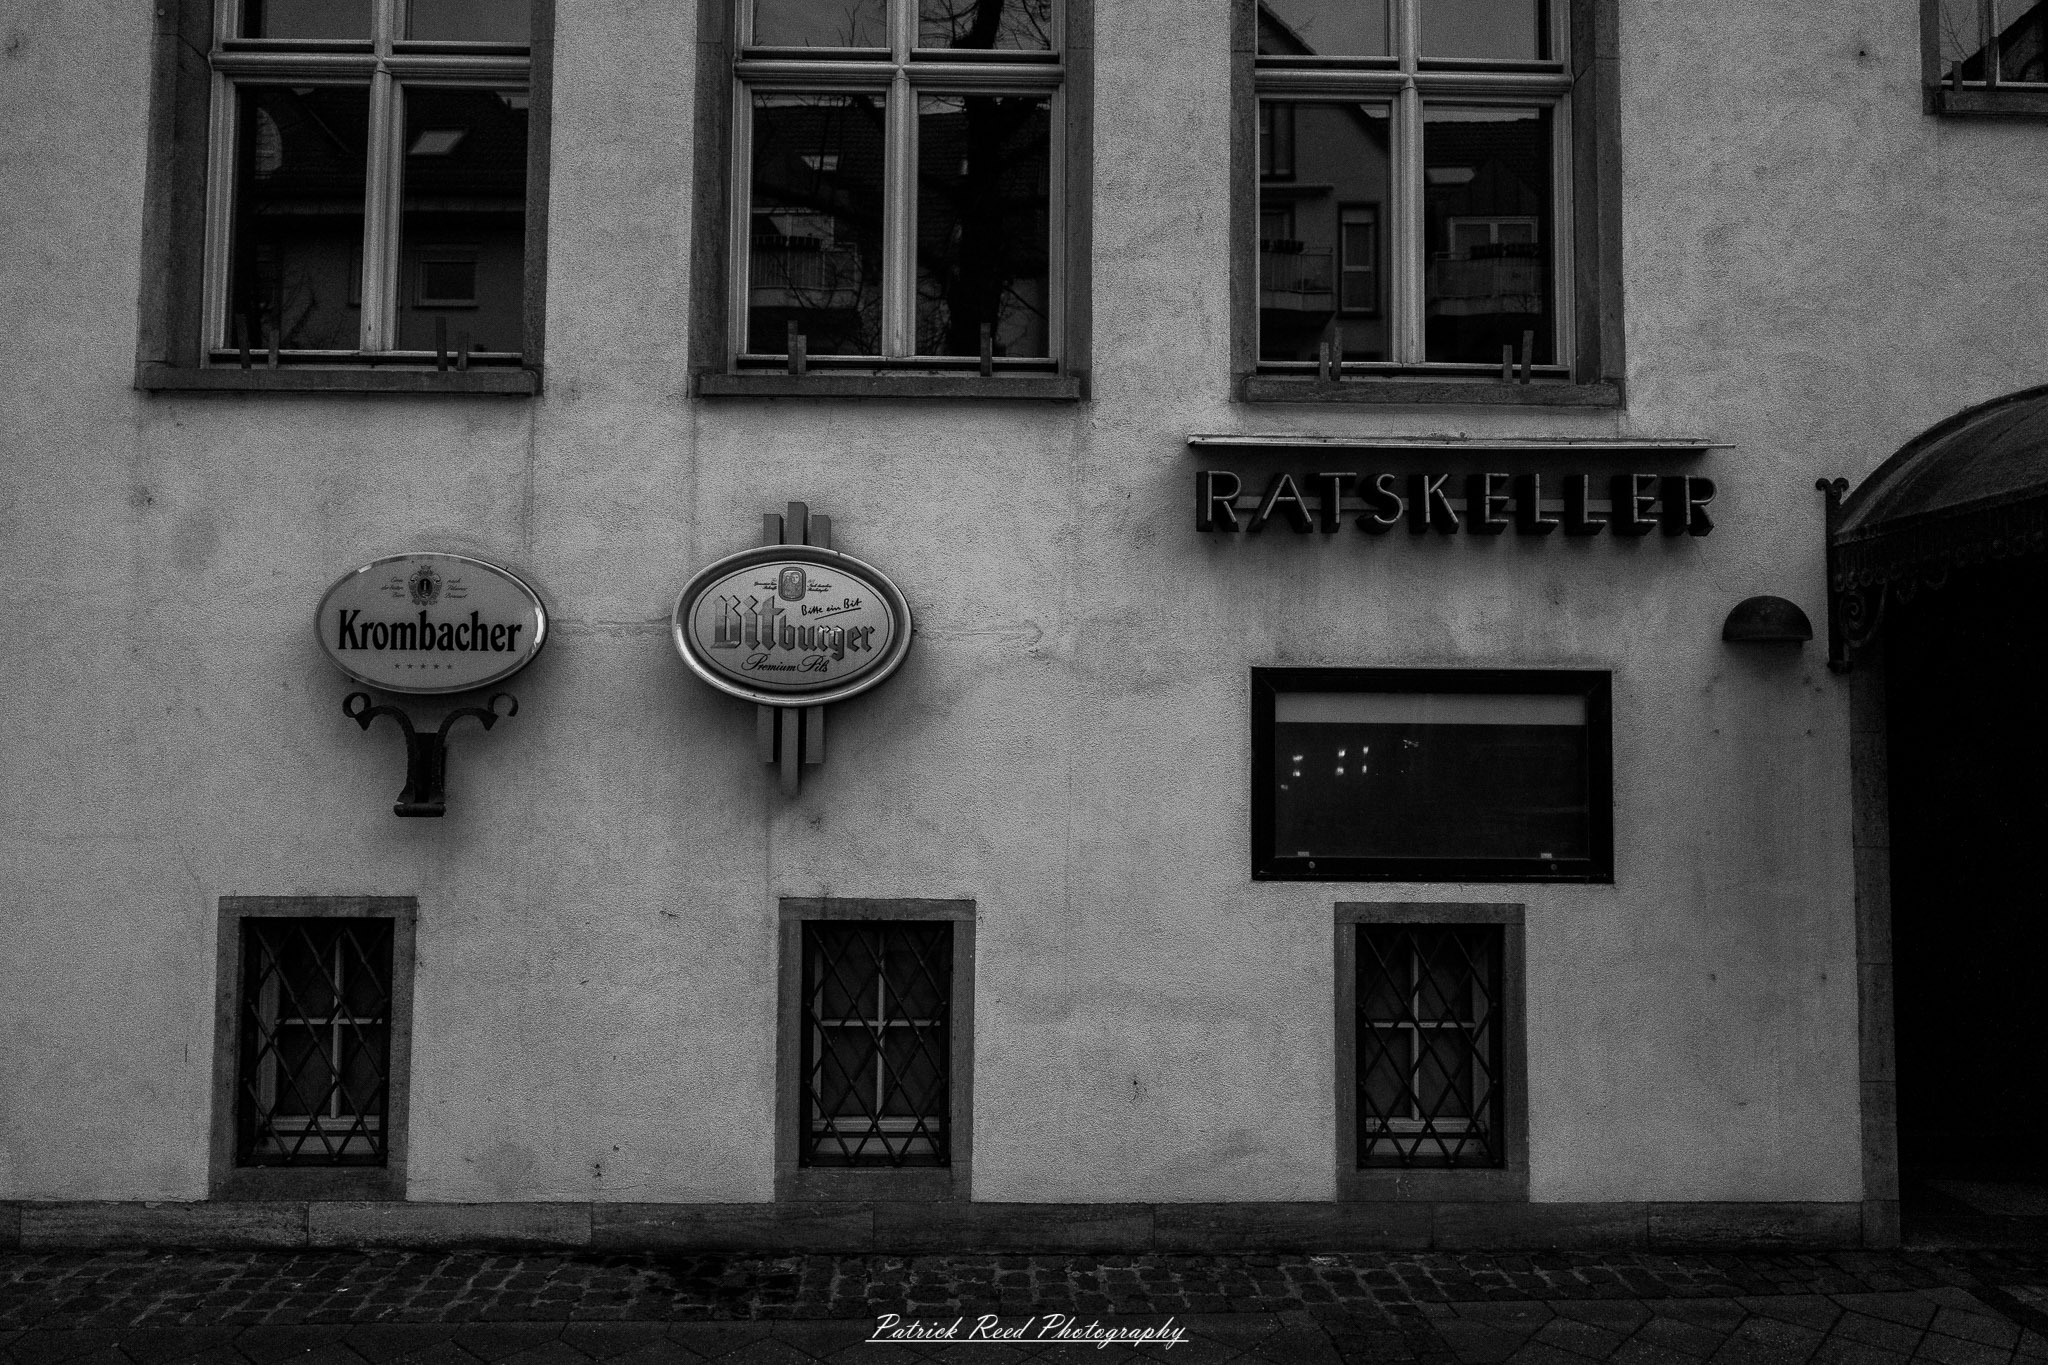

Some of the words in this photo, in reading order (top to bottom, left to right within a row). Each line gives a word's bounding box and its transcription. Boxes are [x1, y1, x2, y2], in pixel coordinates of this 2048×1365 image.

[1196, 471, 1717, 536] RATSKELLER
[710, 595, 875, 661] Bitburger
[801, 605, 823, 616] Bitte
[844, 598, 862, 608] Bit
[338, 609, 523, 652] Krombacher
[741, 653, 797, 672] Premium
[797, 654, 828, 673] Pils
